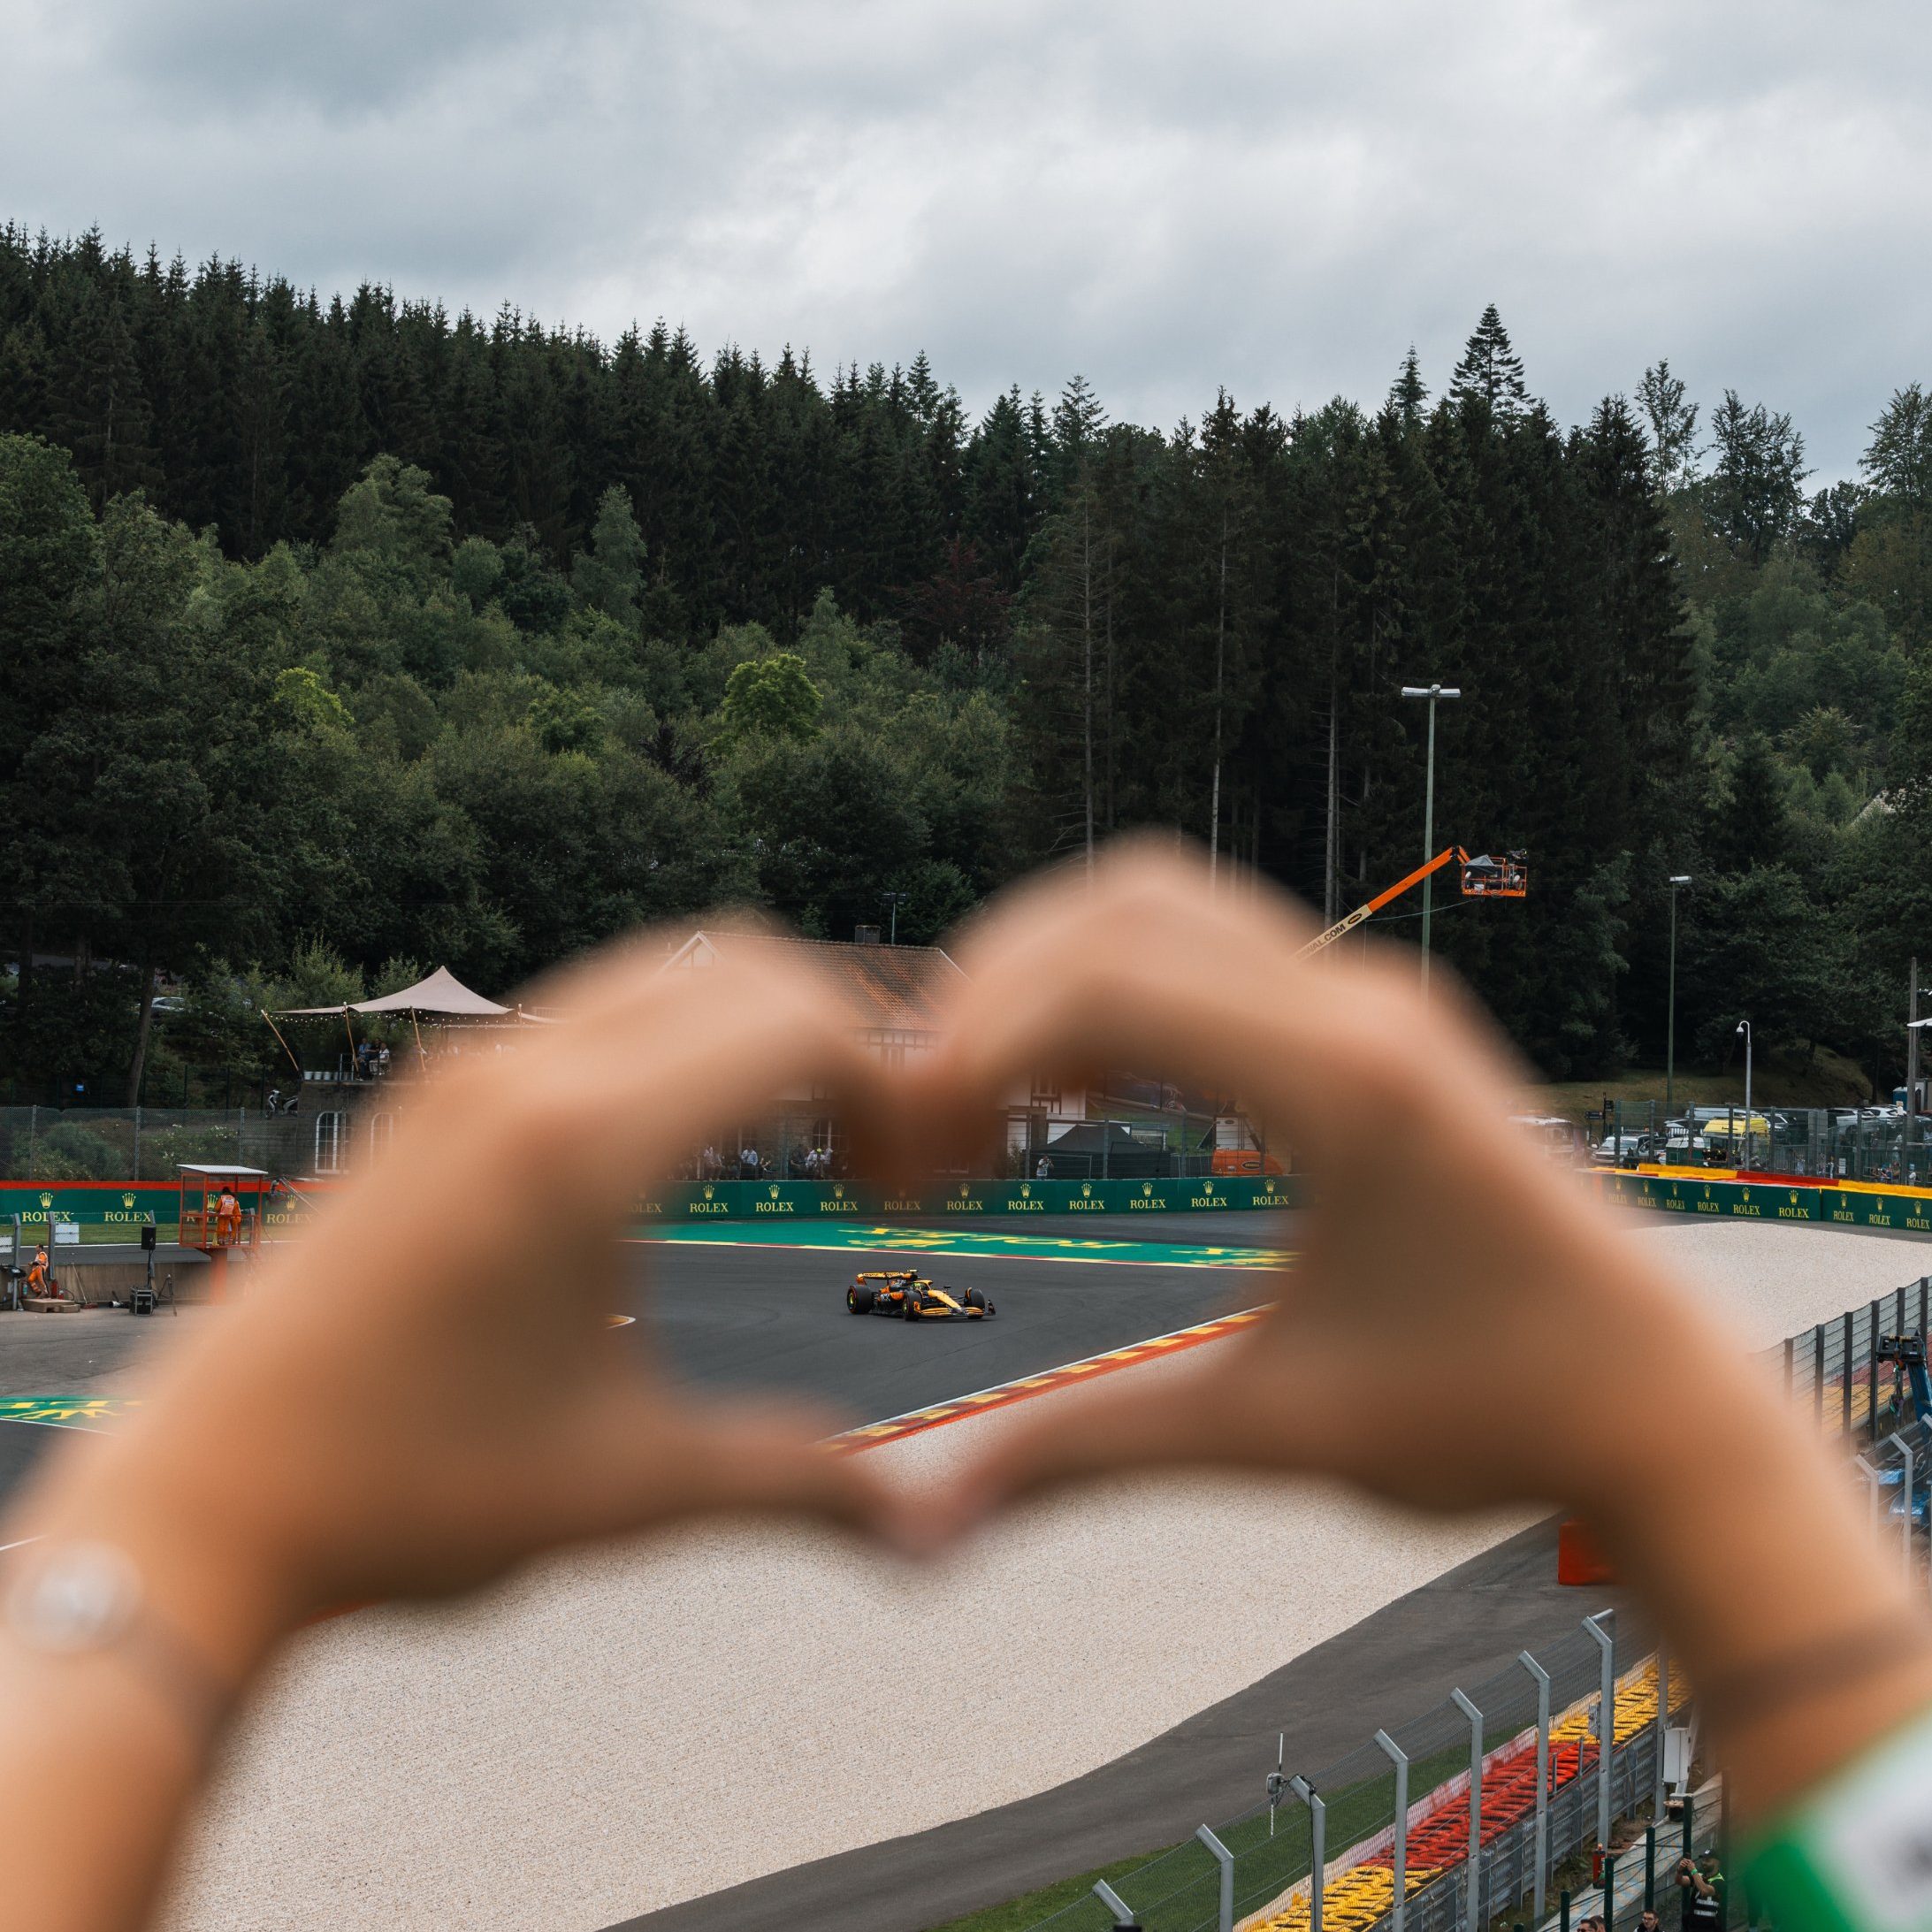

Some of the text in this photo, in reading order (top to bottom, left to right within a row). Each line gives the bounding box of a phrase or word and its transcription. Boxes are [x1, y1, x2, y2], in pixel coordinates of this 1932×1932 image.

[1130, 1199, 1166, 1209] ROLEX
[1191, 1197, 1227, 1207] ROLEX
[1252, 1195, 1289, 1205] ROLEX
[1607, 1194, 1628, 1204] ROLEX
[1638, 1197, 1657, 1208] ROLEX
[689, 1203, 729, 1213] ROLEX
[755, 1202, 794, 1212] ROLEX
[820, 1201, 859, 1211] ROLEX
[884, 1201, 921, 1210] ROLEX
[946, 1201, 983, 1210] ROLEX
[1008, 1201, 1044, 1210] ROLEX
[1069, 1200, 1105, 1210] ROLEX
[1666, 1199, 1685, 1210] ROLEX
[1697, 1201, 1720, 1212] ROLEX
[1733, 1203, 1761, 1216] ROLEX
[104, 1211, 152, 1223] ROLEX
[1778, 1207, 1810, 1218] ROLEX
[1833, 1210, 1854, 1222] ROLEX
[1868, 1213, 1890, 1226] ROLEX
[1906, 1218, 1930, 1230] ROLEX
